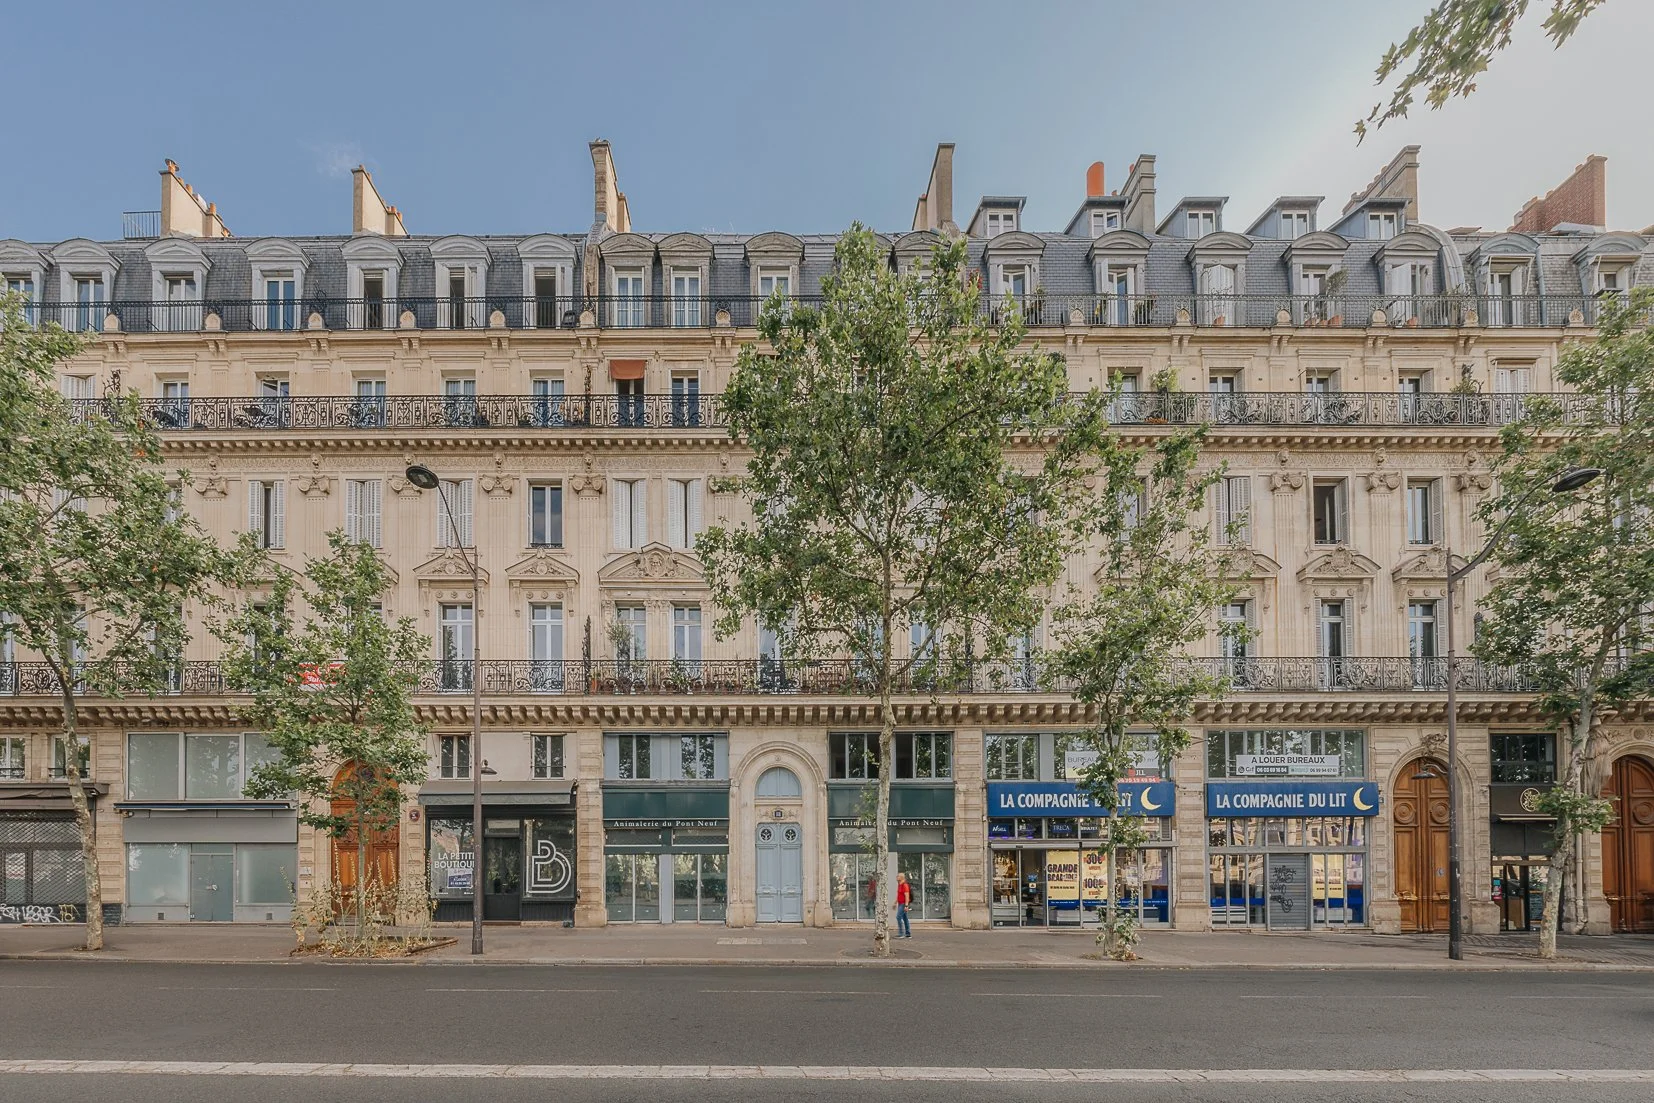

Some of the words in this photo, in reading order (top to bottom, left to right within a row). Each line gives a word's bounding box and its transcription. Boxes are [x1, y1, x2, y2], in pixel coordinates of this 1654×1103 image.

[1251, 756, 1258, 764] A
[1259, 756, 1286, 764] LOUER
[1287, 756, 1325, 764] BUREAUX
[1000, 793, 1015, 808] LA
[1017, 793, 1090, 808] COMPAGNIE
[1216, 794, 1231, 809] LA
[1233, 793, 1304, 809] COMPAGNIE
[1309, 793, 1326, 808] DU
[1329, 792, 1347, 808] LIT
[438, 852, 449, 860] LA
[1047, 863, 1078, 873] GRANDE
